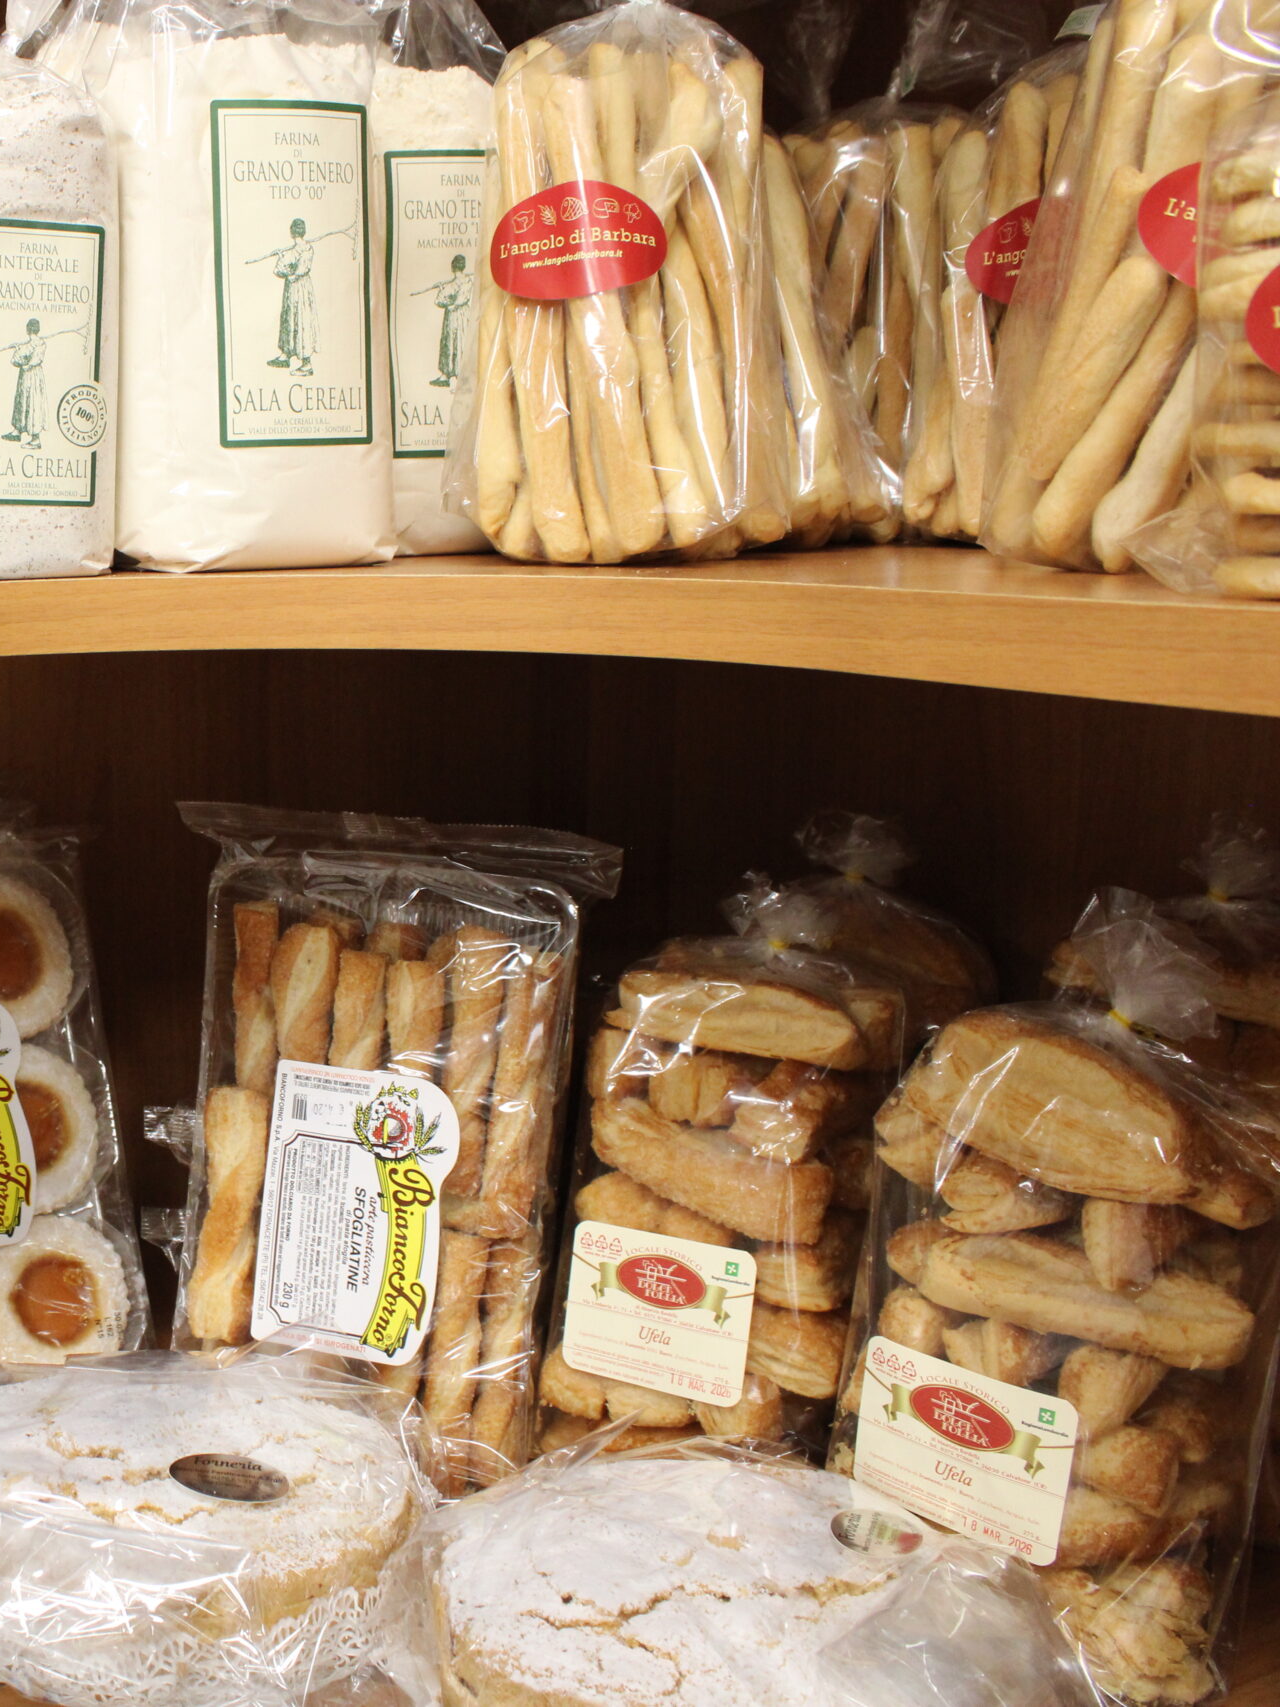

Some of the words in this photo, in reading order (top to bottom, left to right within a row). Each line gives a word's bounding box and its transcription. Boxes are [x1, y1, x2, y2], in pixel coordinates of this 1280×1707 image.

[274, 132, 320, 147] FARINA
[293, 149, 302, 158] DI
[233, 160, 294, 183] GRANO
[297, 161, 354, 184] TENERO
[440, 174, 480, 187] FARINA
[269, 186, 301, 200] TIPO
[457, 188, 465, 198] DI
[404, 199, 457, 220] GRANO
[439, 221, 468, 235] TIPO
[20, 241, 58, 256] FARINA
[417, 237, 464, 249] MACINATA
[499, 234, 565, 259] L'angolo
[569, 229, 585, 245] di
[591, 226, 656, 248] Barbara
[37, 282, 90, 304] TENERO
[50, 303, 78, 314] PIETRA
[232, 384, 281, 415] SALA
[288, 383, 362, 414] CEREALI
[75, 405, 96, 425] 100%
[400, 401, 444, 428] SALA
[22, 454, 88, 479] CEREALI
[278, 1072, 289, 1122] BIANCOFORNO
[368, 1196, 378, 1216] arte
[343, 1218, 351, 1240] pasta
[346, 1186, 367, 1294] SFOGLIATINE
[625, 1246, 662, 1257] LOCALE
[663, 1246, 703, 1272] STORICO
[282, 1280, 294, 1299] 230
[280, 1300, 290, 1309] g
[638, 1325, 672, 1346] Ufela
[920, 1375, 962, 1391] LOCALE
[963, 1380, 1010, 1415] STORICO
[934, 1459, 973, 1487] Ufela
[1008, 1536, 1033, 1556] 2026
